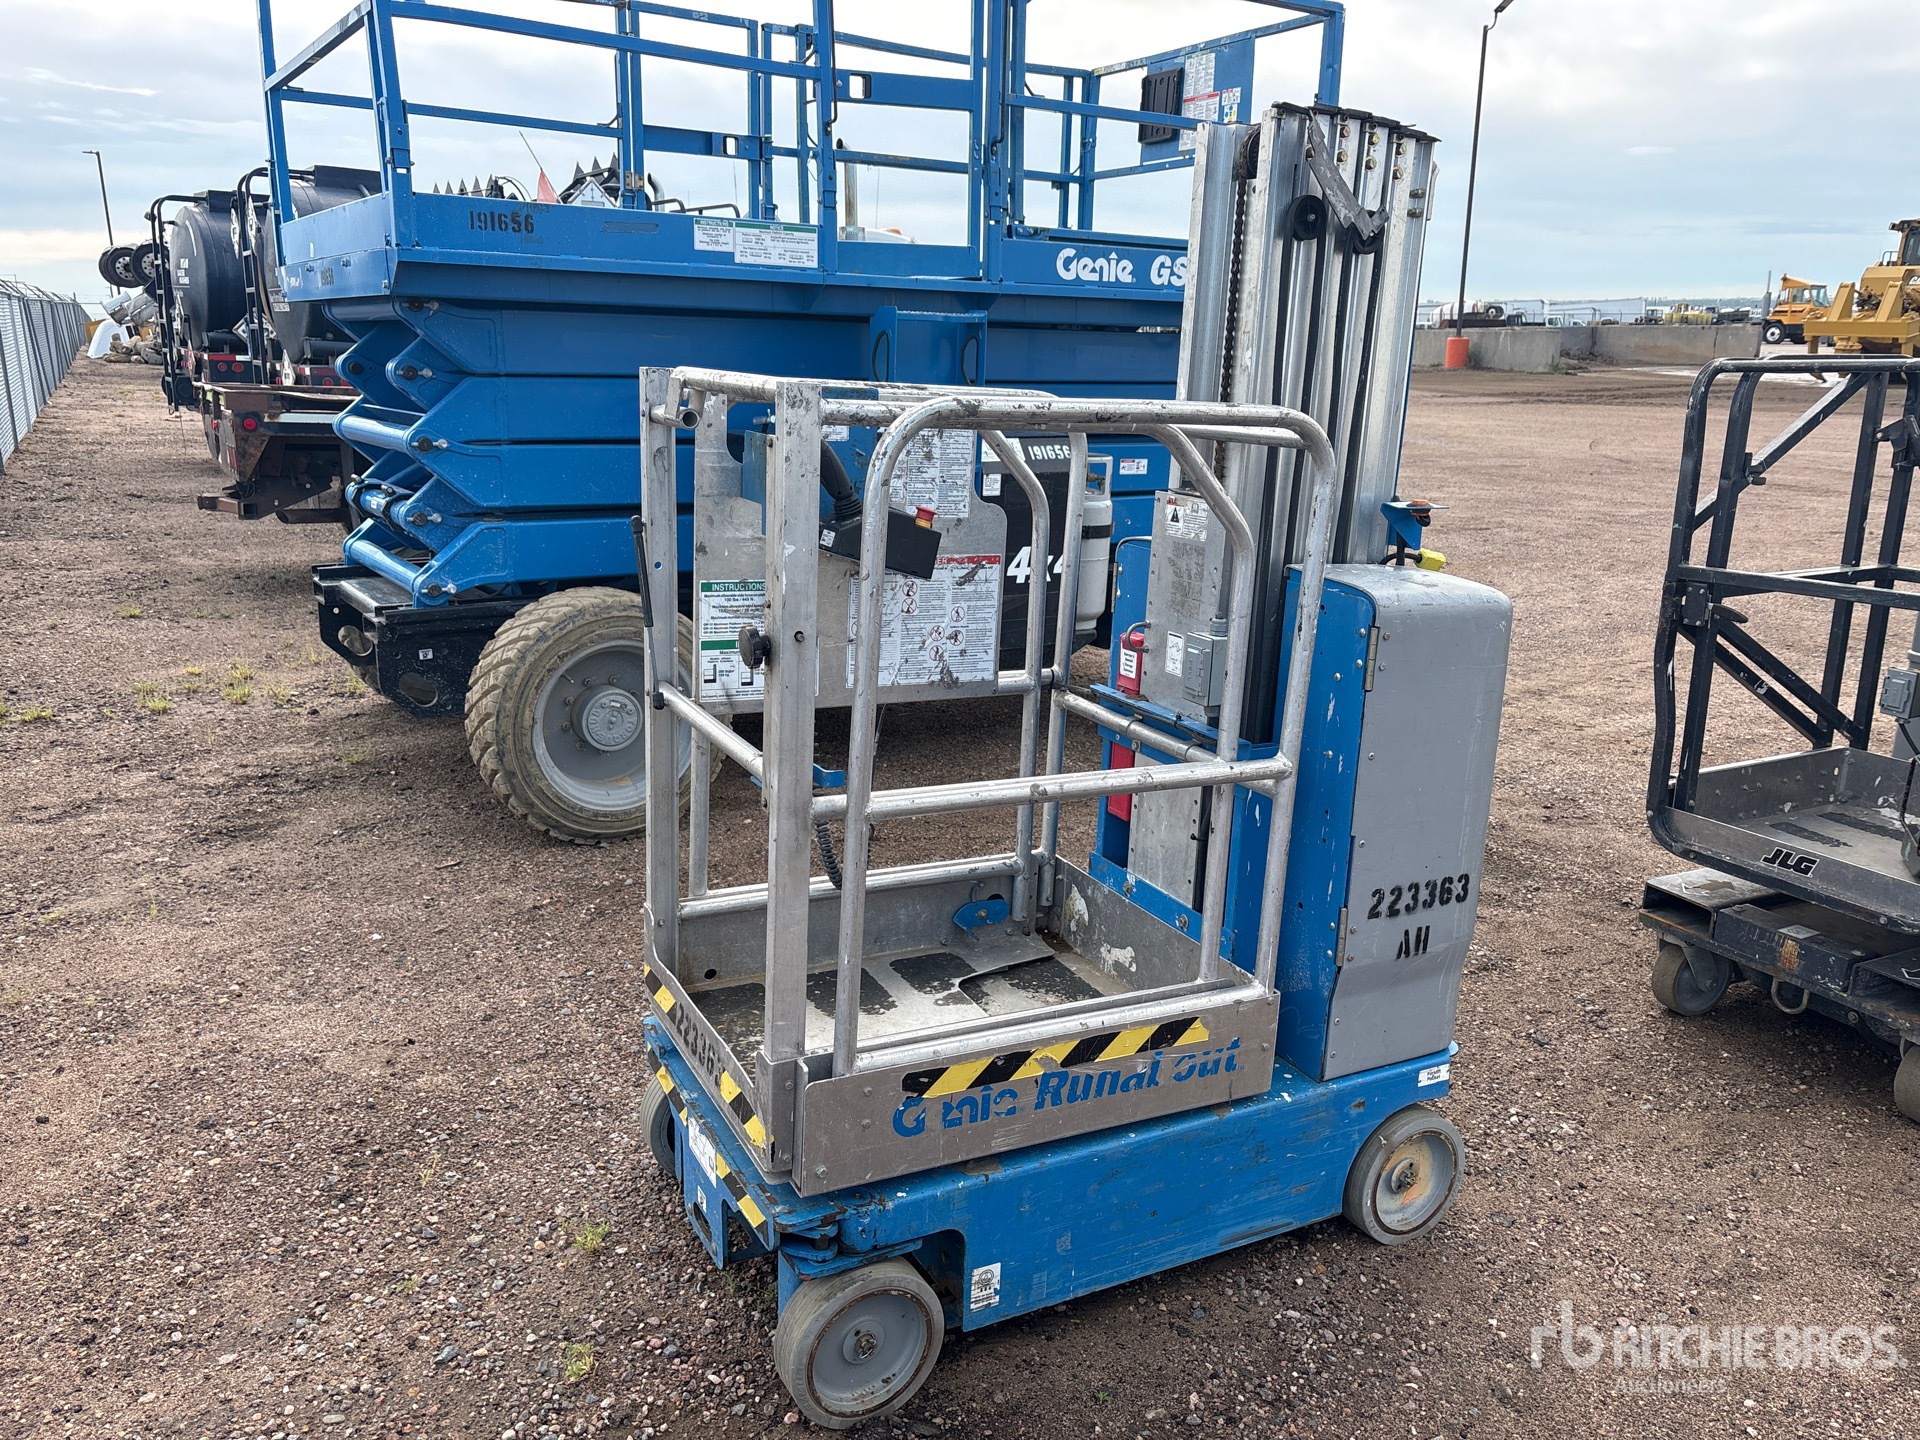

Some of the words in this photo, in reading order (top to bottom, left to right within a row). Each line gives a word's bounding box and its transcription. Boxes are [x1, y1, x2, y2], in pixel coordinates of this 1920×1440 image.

[468, 210, 535, 234] 191656
[1056, 248, 1133, 282] Genie
[1028, 445, 1070, 460] 191656
[712, 582, 766, 591] INSTRUCTIONS
[1760, 847, 1819, 877] JLG
[1367, 873, 1470, 920] 223363
